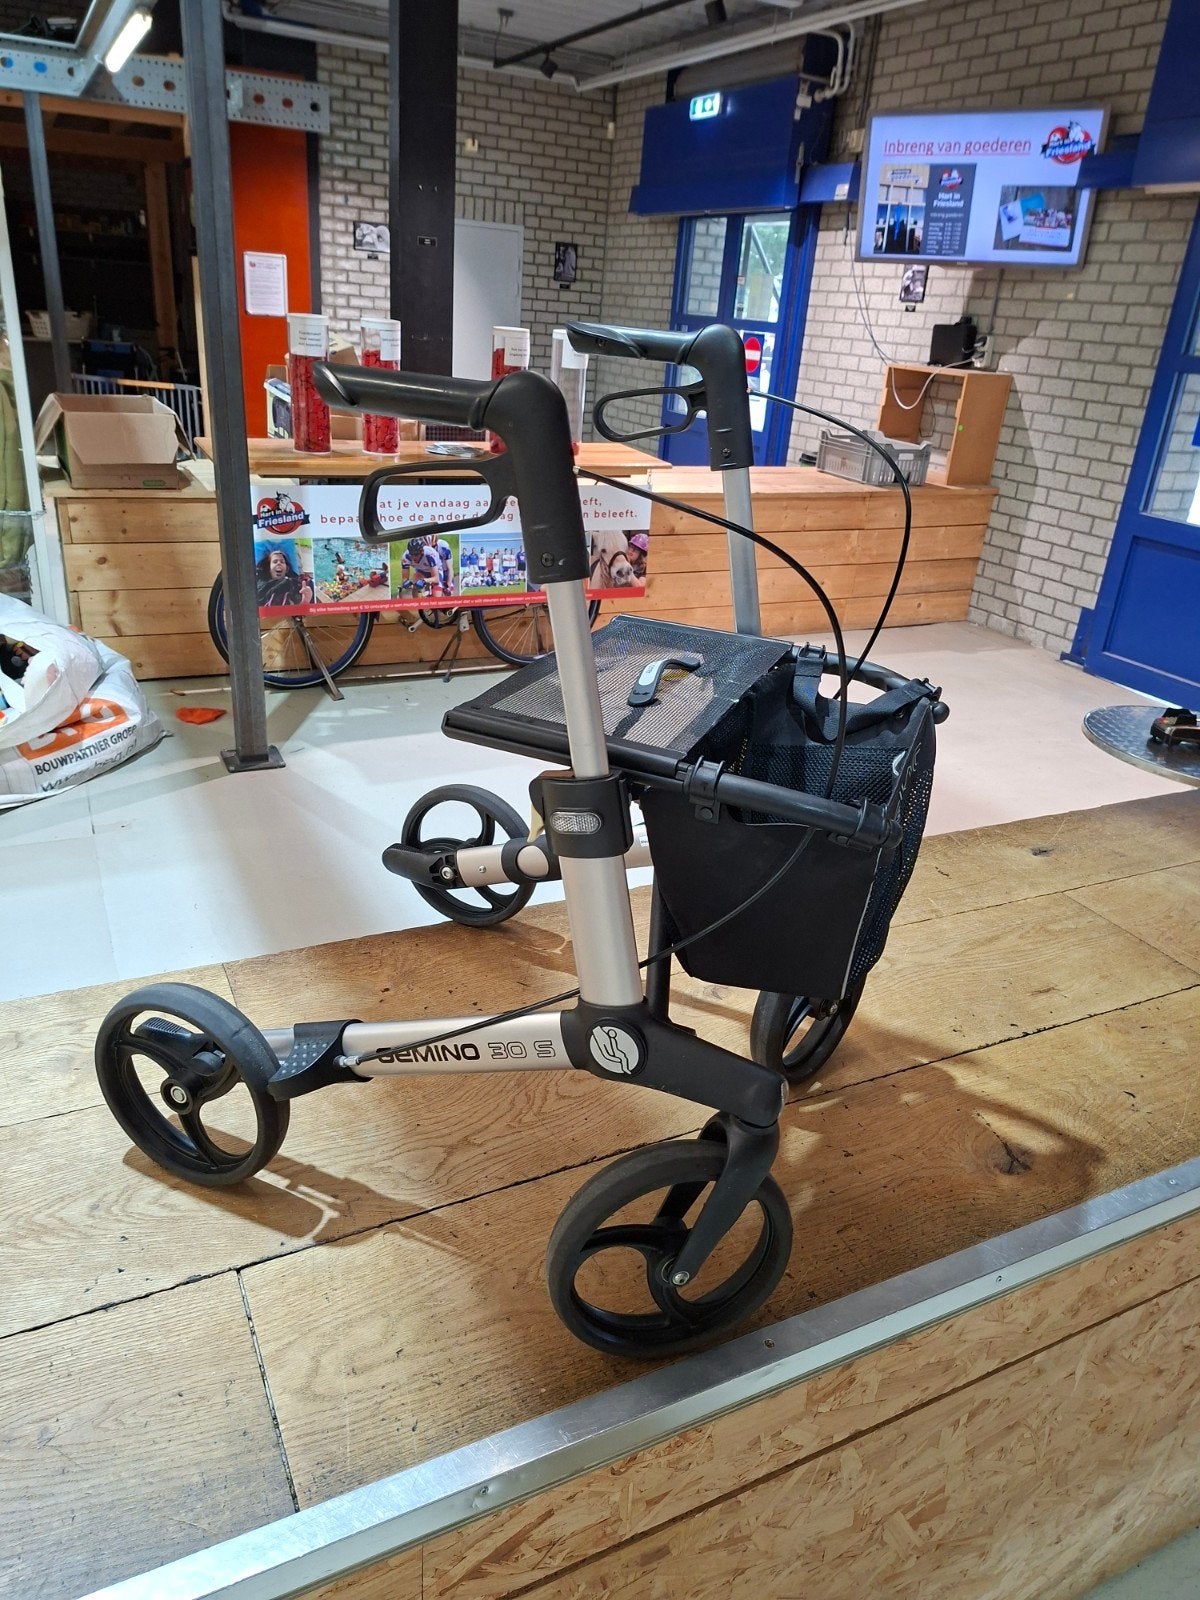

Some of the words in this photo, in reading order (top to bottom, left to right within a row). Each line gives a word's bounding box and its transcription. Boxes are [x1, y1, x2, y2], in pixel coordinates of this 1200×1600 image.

[884, 139, 934, 156] Inbreng
[938, 141, 961, 153] van
[964, 138, 1032, 155] goederen
[397, 499, 410, 510] je
[415, 499, 470, 509] vandaag
[258, 511, 304, 528] Friesland
[380, 513, 403, 522] hoe
[409, 512, 424, 522] de
[430, 512, 466, 521] ander
[594, 509, 638, 518] beleeft.
[34, 738, 110, 776] BOUWPARTNER
[110, 725, 137, 746] GROEP
[488, 1041, 527, 1060] 30
[536, 1040, 556, 1059] S
